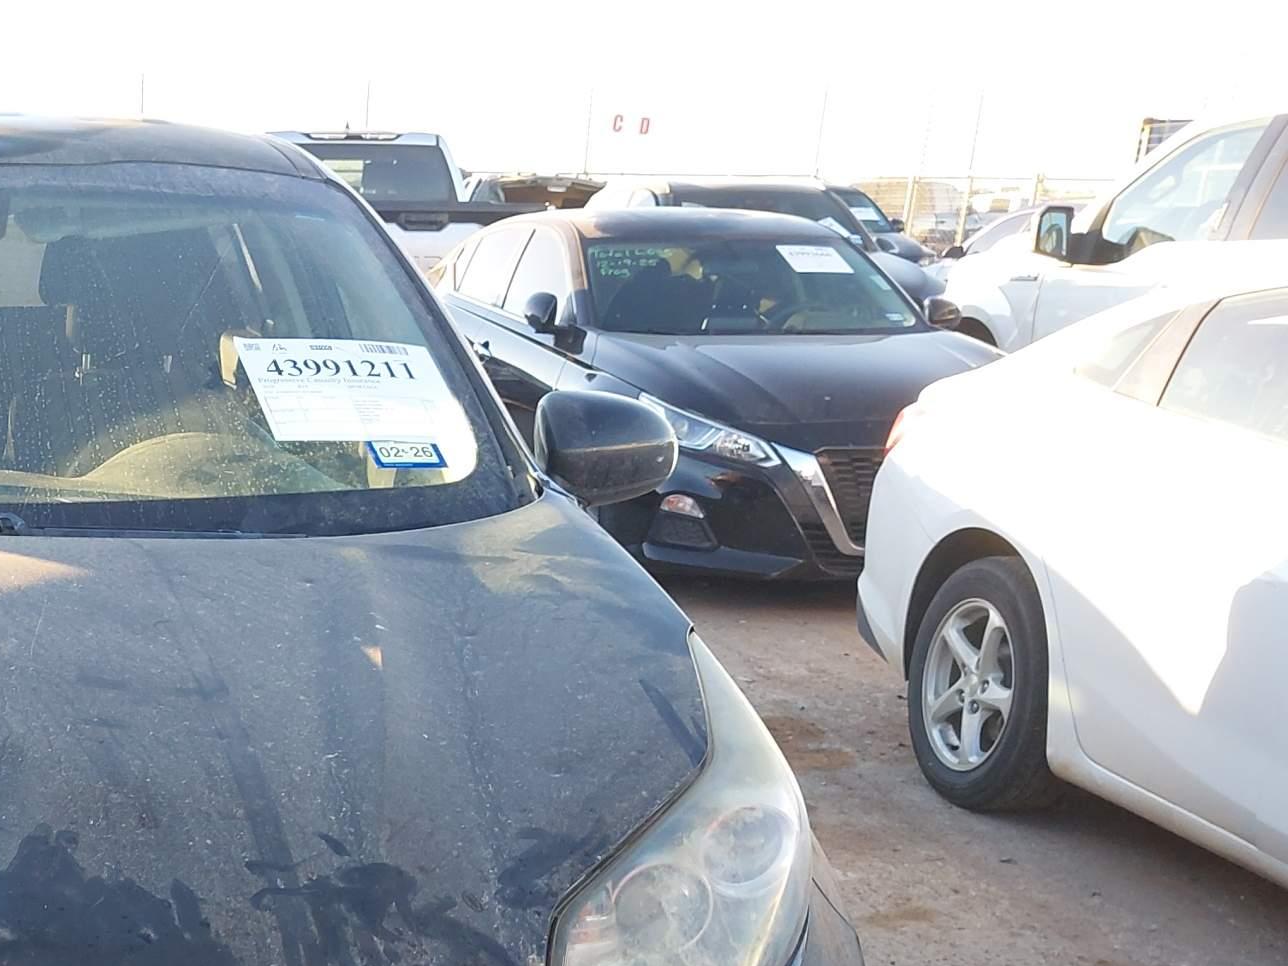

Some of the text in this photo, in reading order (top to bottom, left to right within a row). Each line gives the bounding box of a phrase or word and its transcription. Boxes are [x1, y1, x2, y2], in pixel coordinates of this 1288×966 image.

[613, 114, 650, 134] C D
[266, 358, 416, 380] 43991211
